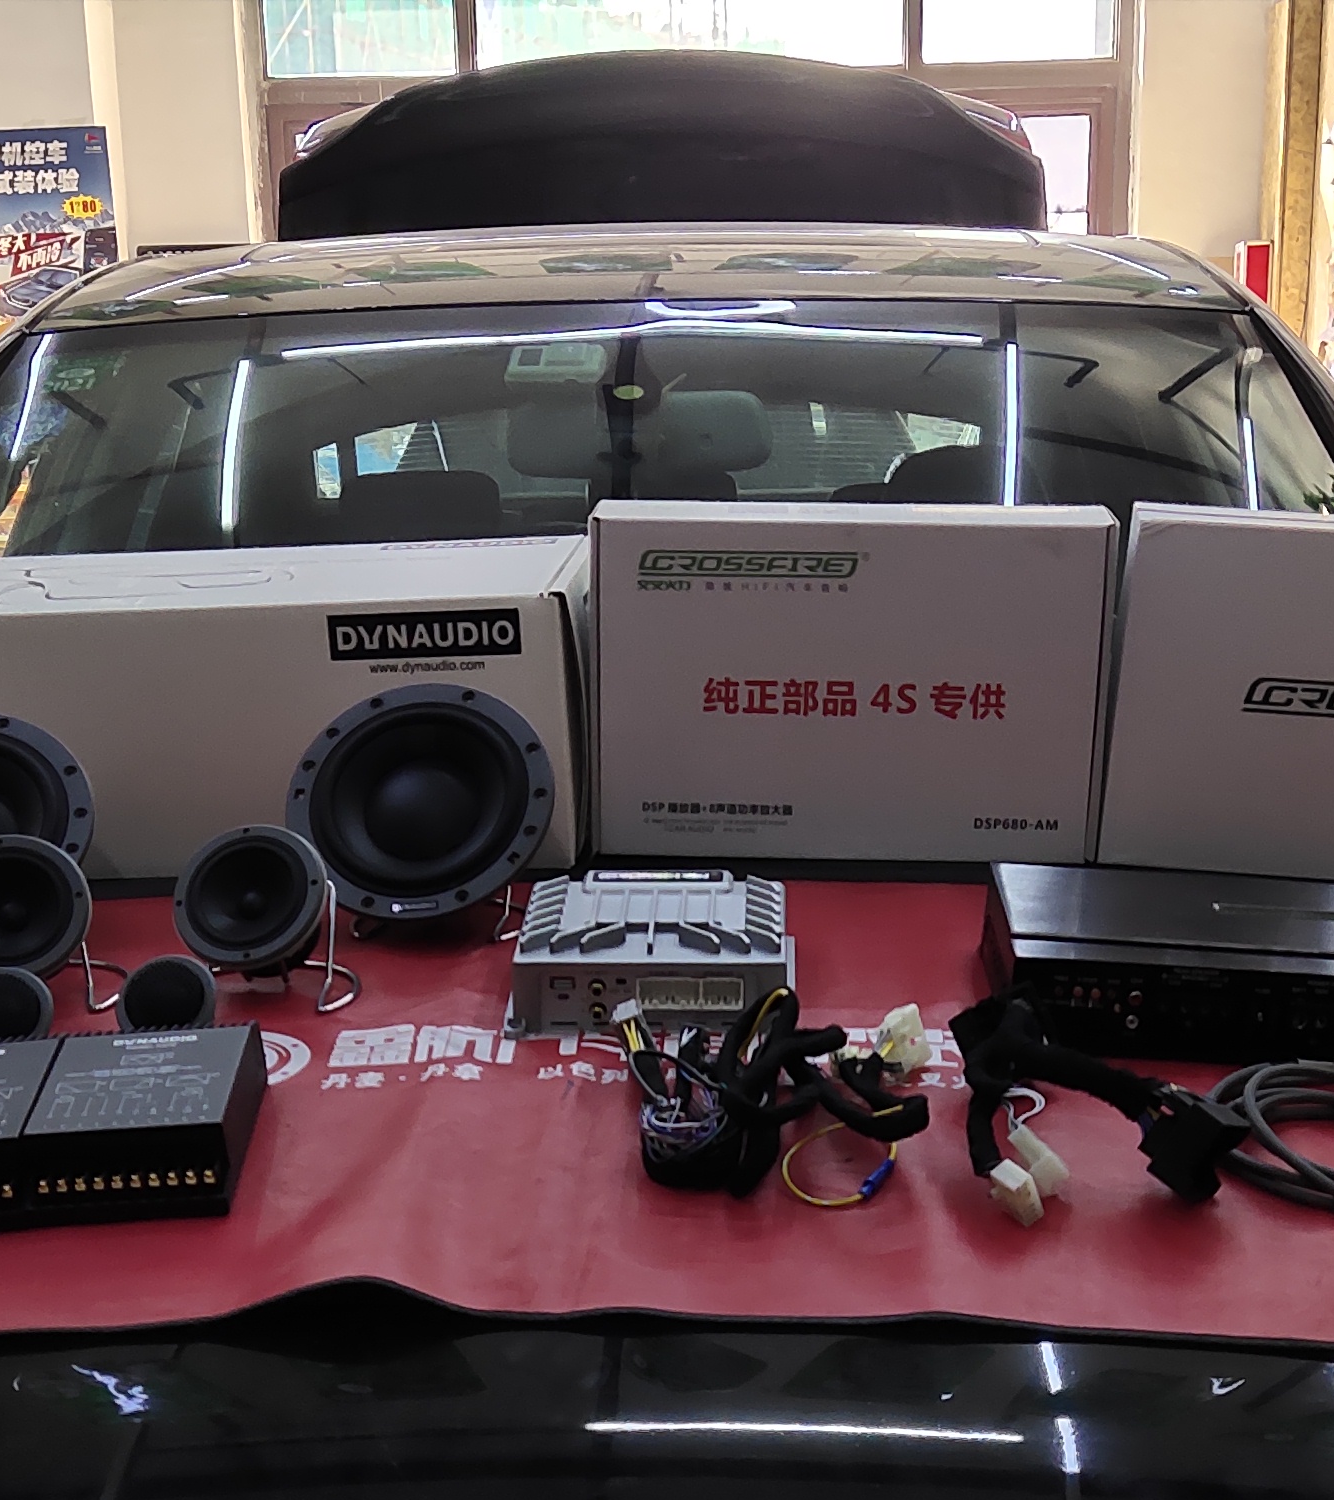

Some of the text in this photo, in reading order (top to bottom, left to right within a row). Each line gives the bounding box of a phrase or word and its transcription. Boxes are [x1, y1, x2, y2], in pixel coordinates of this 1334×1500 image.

[643, 552, 857, 577] CROSSFIRE
[335, 620, 515, 651] DYNAUDIO
[369, 660, 486, 675] www.dynaudio.com
[703, 677, 1007, 720] 纯正部品 4S 专供
[973, 817, 1059, 831] DSP680-AM
